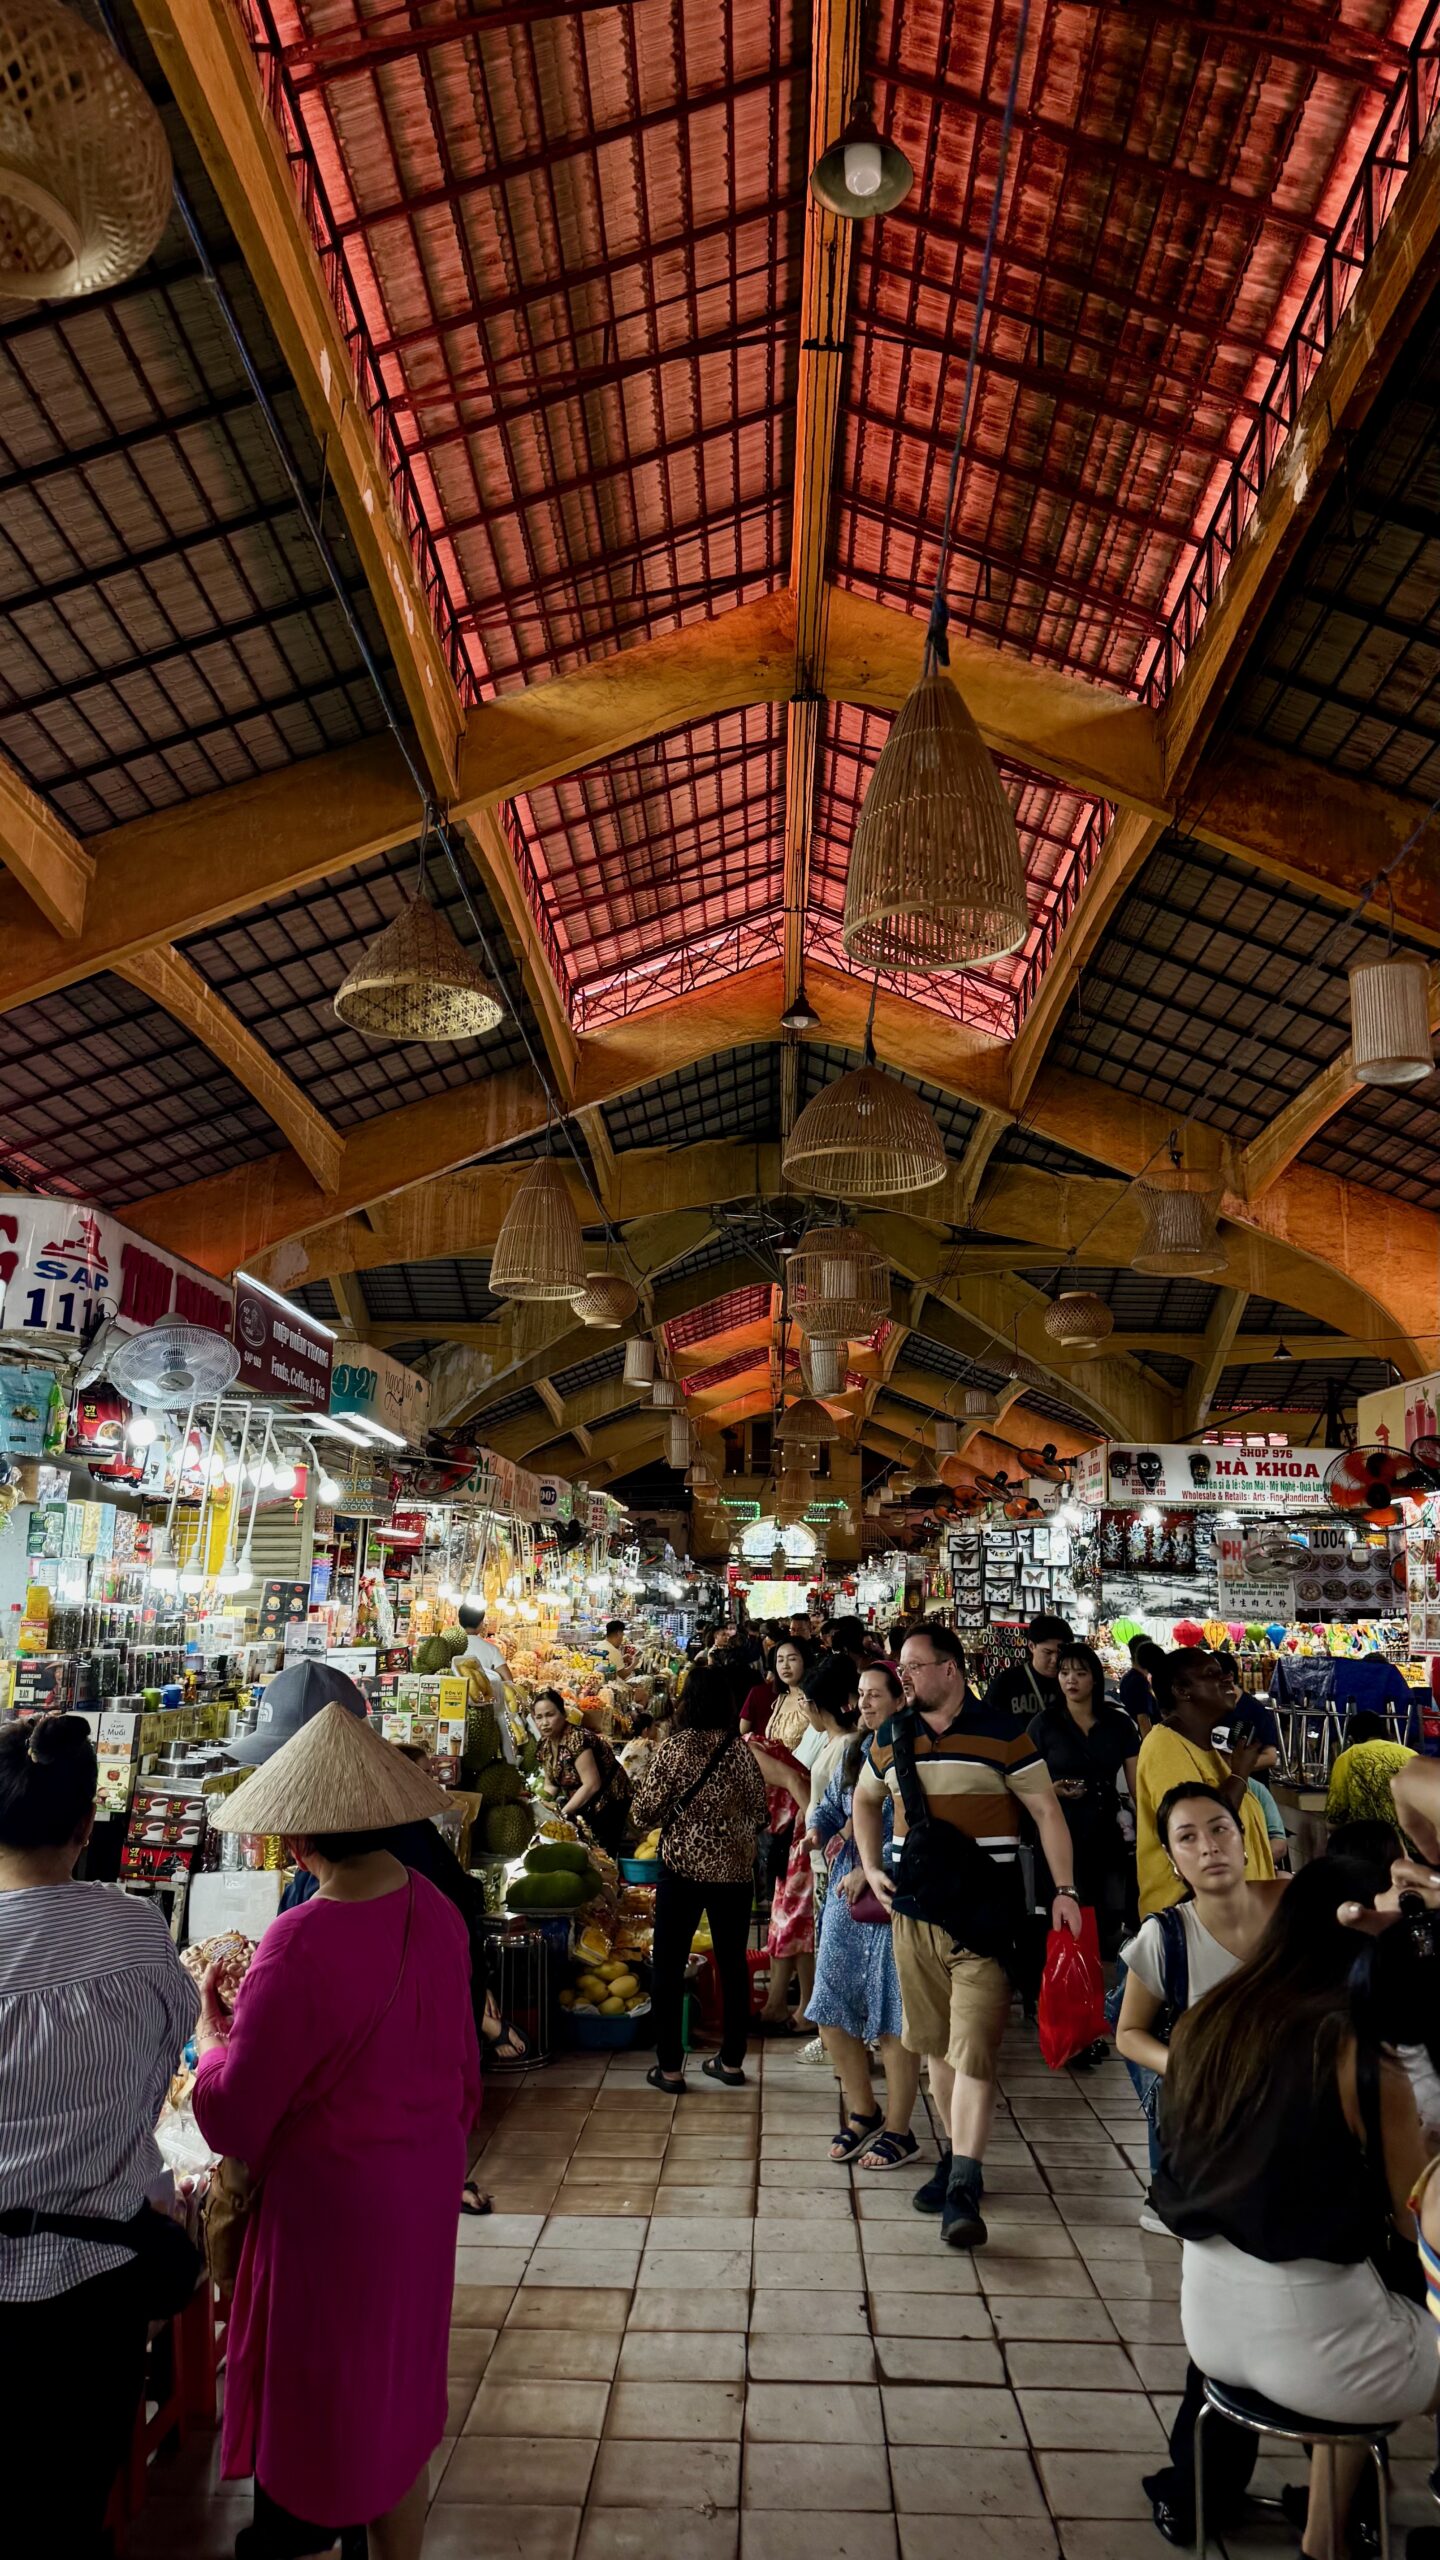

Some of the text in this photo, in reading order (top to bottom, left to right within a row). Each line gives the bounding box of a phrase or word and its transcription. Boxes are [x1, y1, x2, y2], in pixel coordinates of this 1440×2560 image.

[34, 1260, 109, 1291] SẠP
[290, 1367, 310, 1392] Coffee
[310, 1377, 315, 1395] &
[315, 1379, 326, 1400] Tea
[1240, 1449, 1293, 1459] SHOP 976
[1216, 1457, 1319, 1478] HÀ KHOA
[1182, 1490, 1216, 1501] Wholesale
[1217, 1491, 1222, 1500] &
[1252, 1492, 1265, 1501] Arts
[1270, 1493, 1283, 1502] Fine
[1285, 1494, 1320, 1503] Handicraft
[1313, 1530, 1346, 1549] 1004
